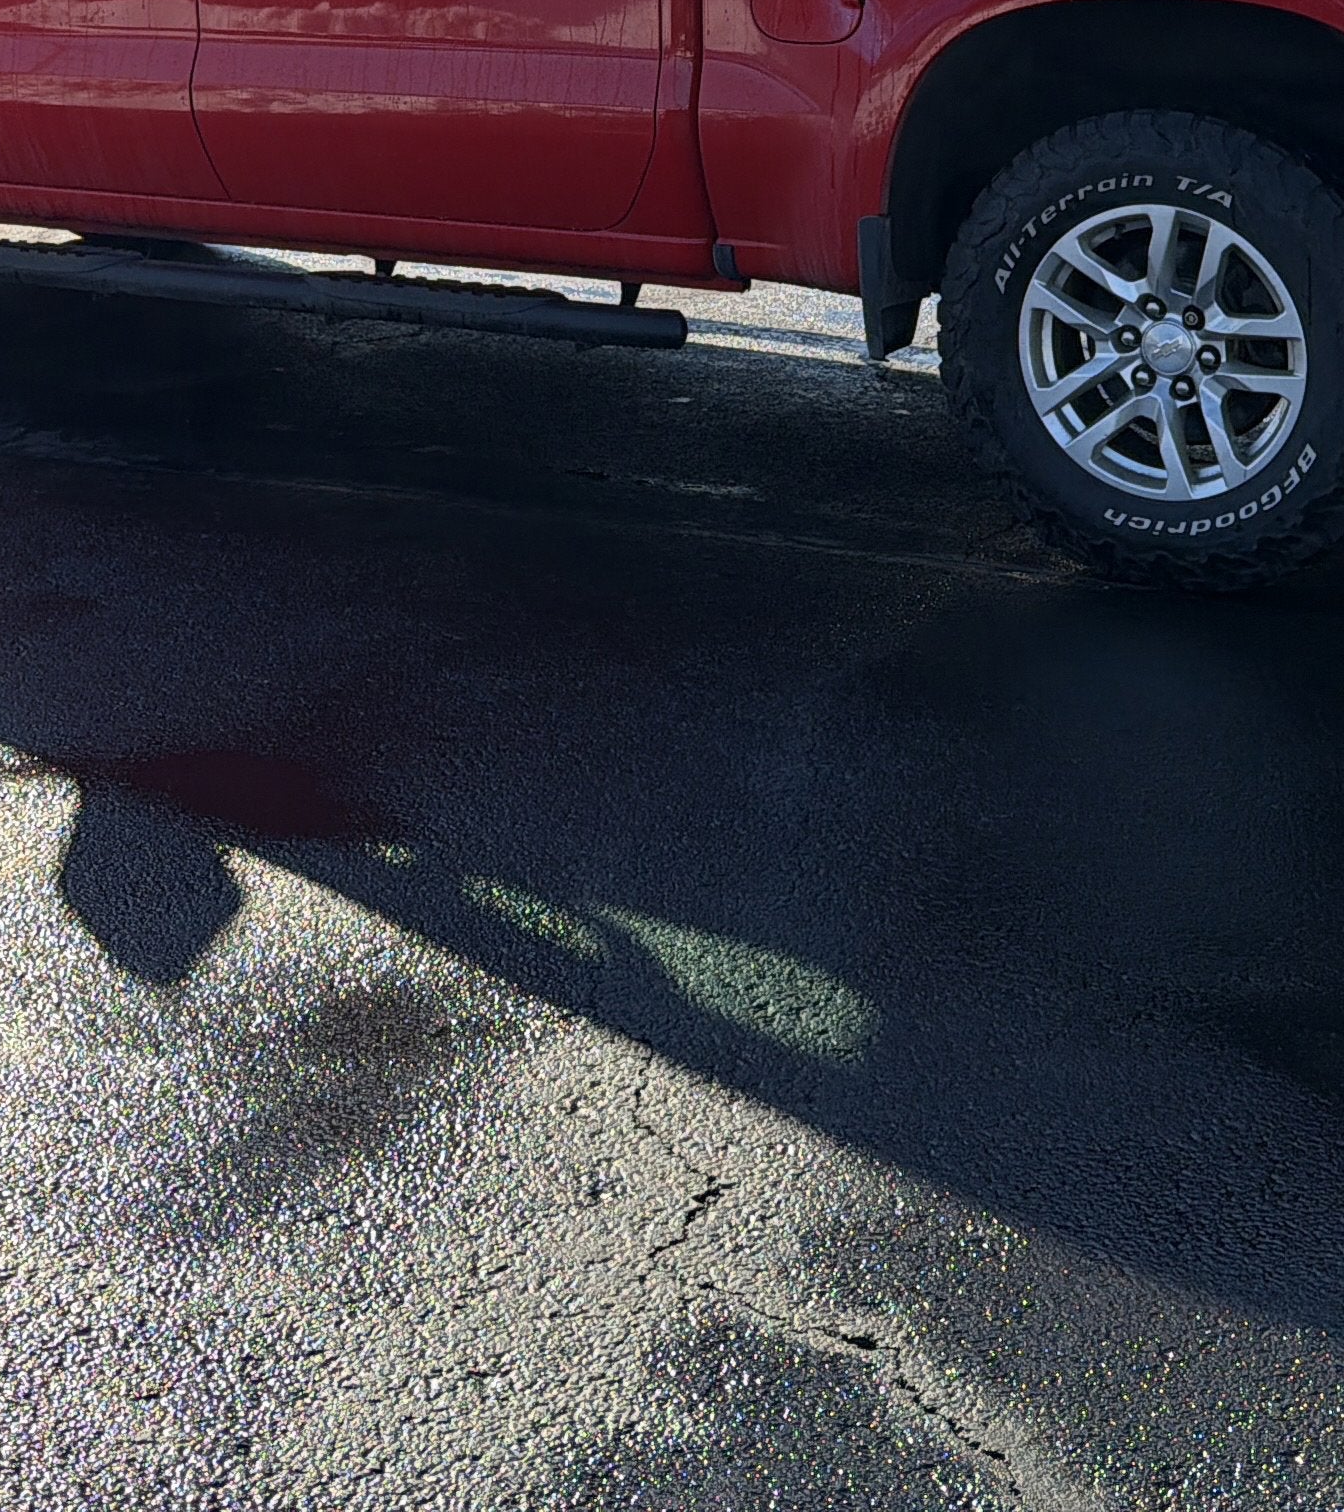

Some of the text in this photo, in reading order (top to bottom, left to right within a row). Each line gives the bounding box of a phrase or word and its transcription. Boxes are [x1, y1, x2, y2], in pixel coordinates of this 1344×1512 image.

[995, 172, 1234, 294] All-Terrain T/A
[1103, 443, 1317, 537] BFGoodrich
